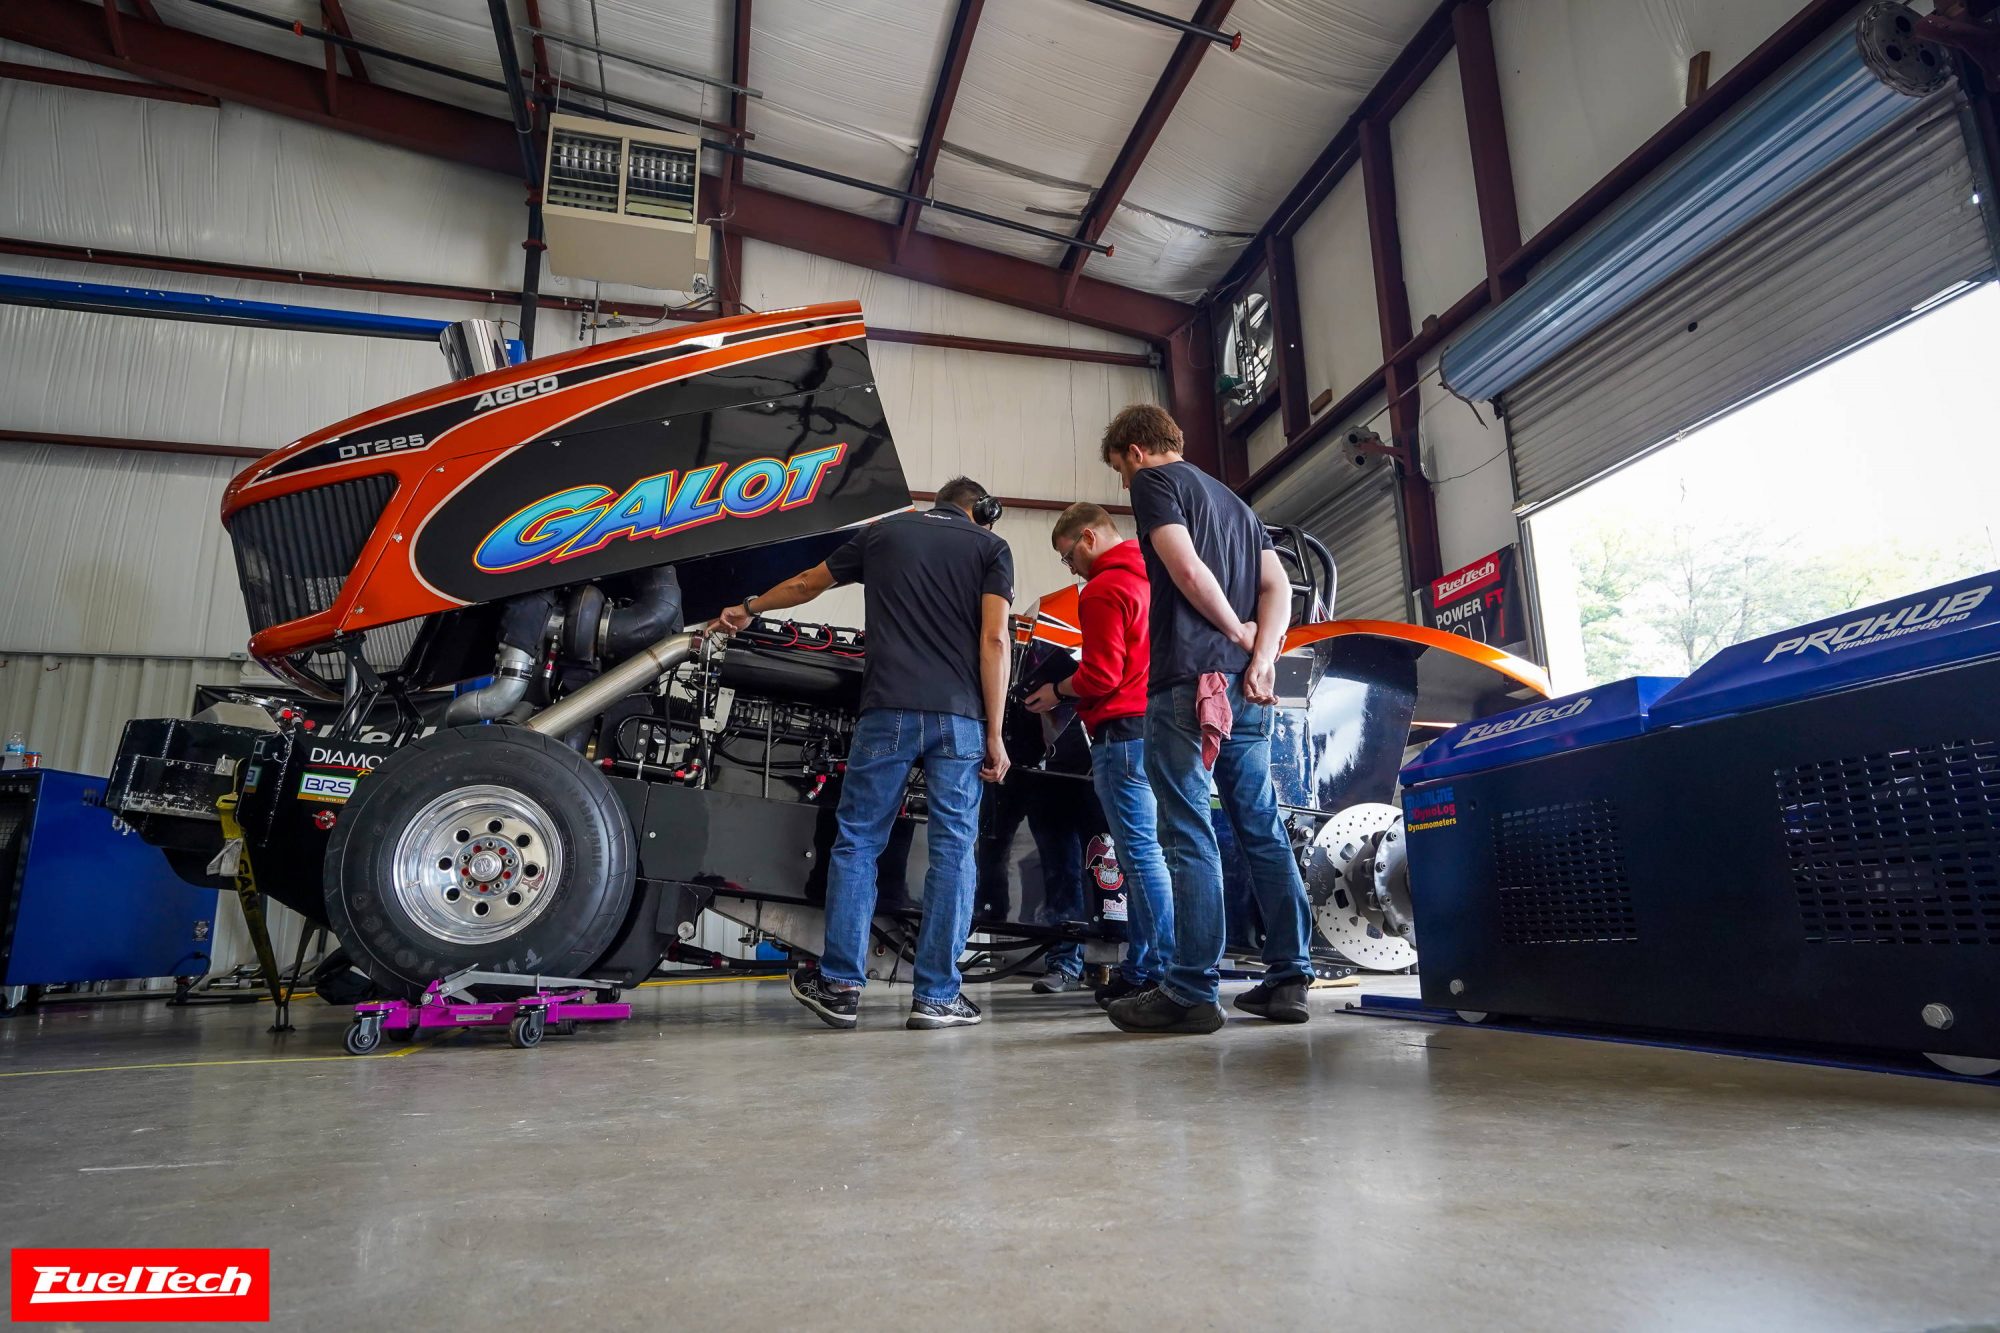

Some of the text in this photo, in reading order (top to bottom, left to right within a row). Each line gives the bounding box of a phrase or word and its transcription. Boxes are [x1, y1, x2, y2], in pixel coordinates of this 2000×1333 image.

[473, 375, 559, 412] AGCO
[338, 433, 425, 459] DT225
[471, 443, 848, 574] GALOT
[1437, 561, 1495, 597] FuelTech
[1435, 598, 1482, 629] POWER
[1762, 585, 1993, 664] PROHUB
[1833, 611, 1971, 653] #mainlinedyno
[1457, 696, 1593, 745] FuelTech
[310, 747, 387, 770] DIAMO
[304, 777, 352, 794] BRS
[1407, 817, 1457, 832] Dynamometers
